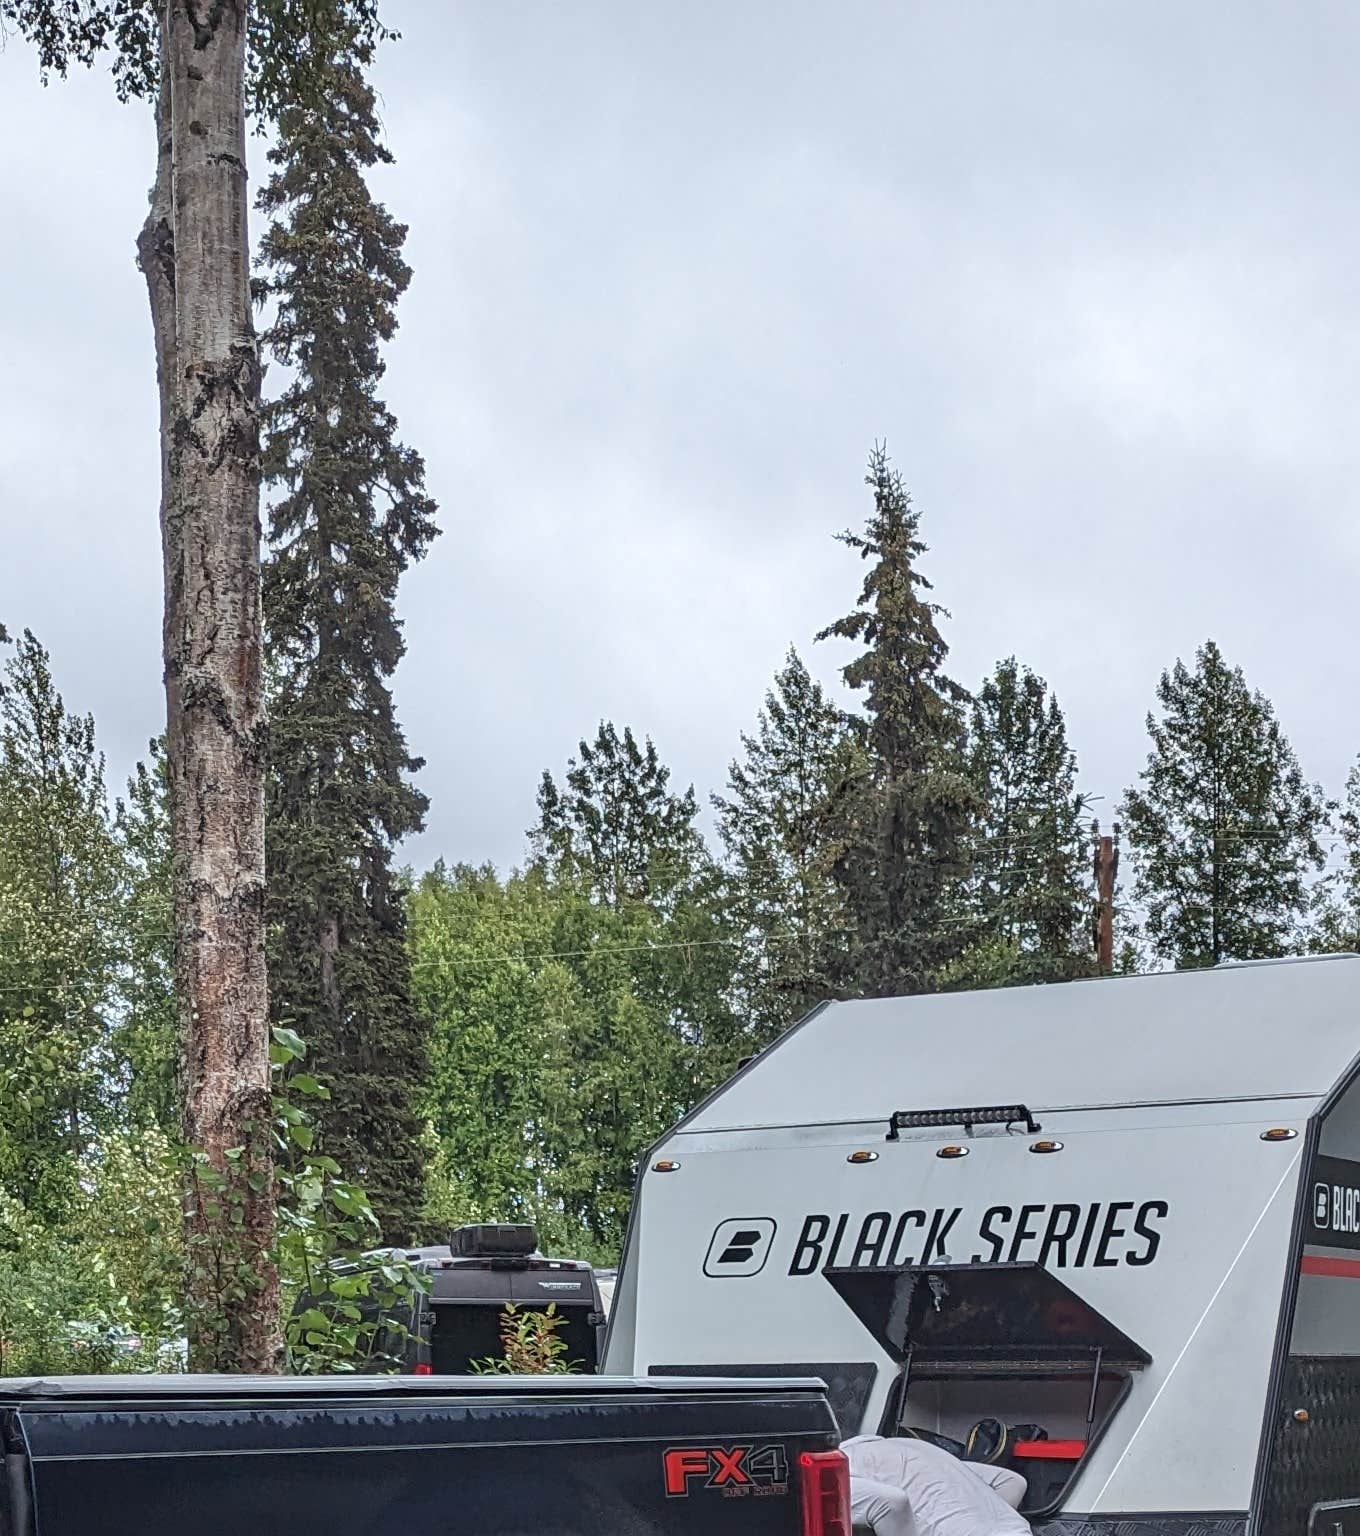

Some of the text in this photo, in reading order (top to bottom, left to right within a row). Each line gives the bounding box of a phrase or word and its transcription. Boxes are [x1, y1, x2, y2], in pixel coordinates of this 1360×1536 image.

[788, 1207, 963, 1276] BLACK
[971, 1200, 1169, 1268] SERIES
[663, 1444, 789, 1498] FX4
